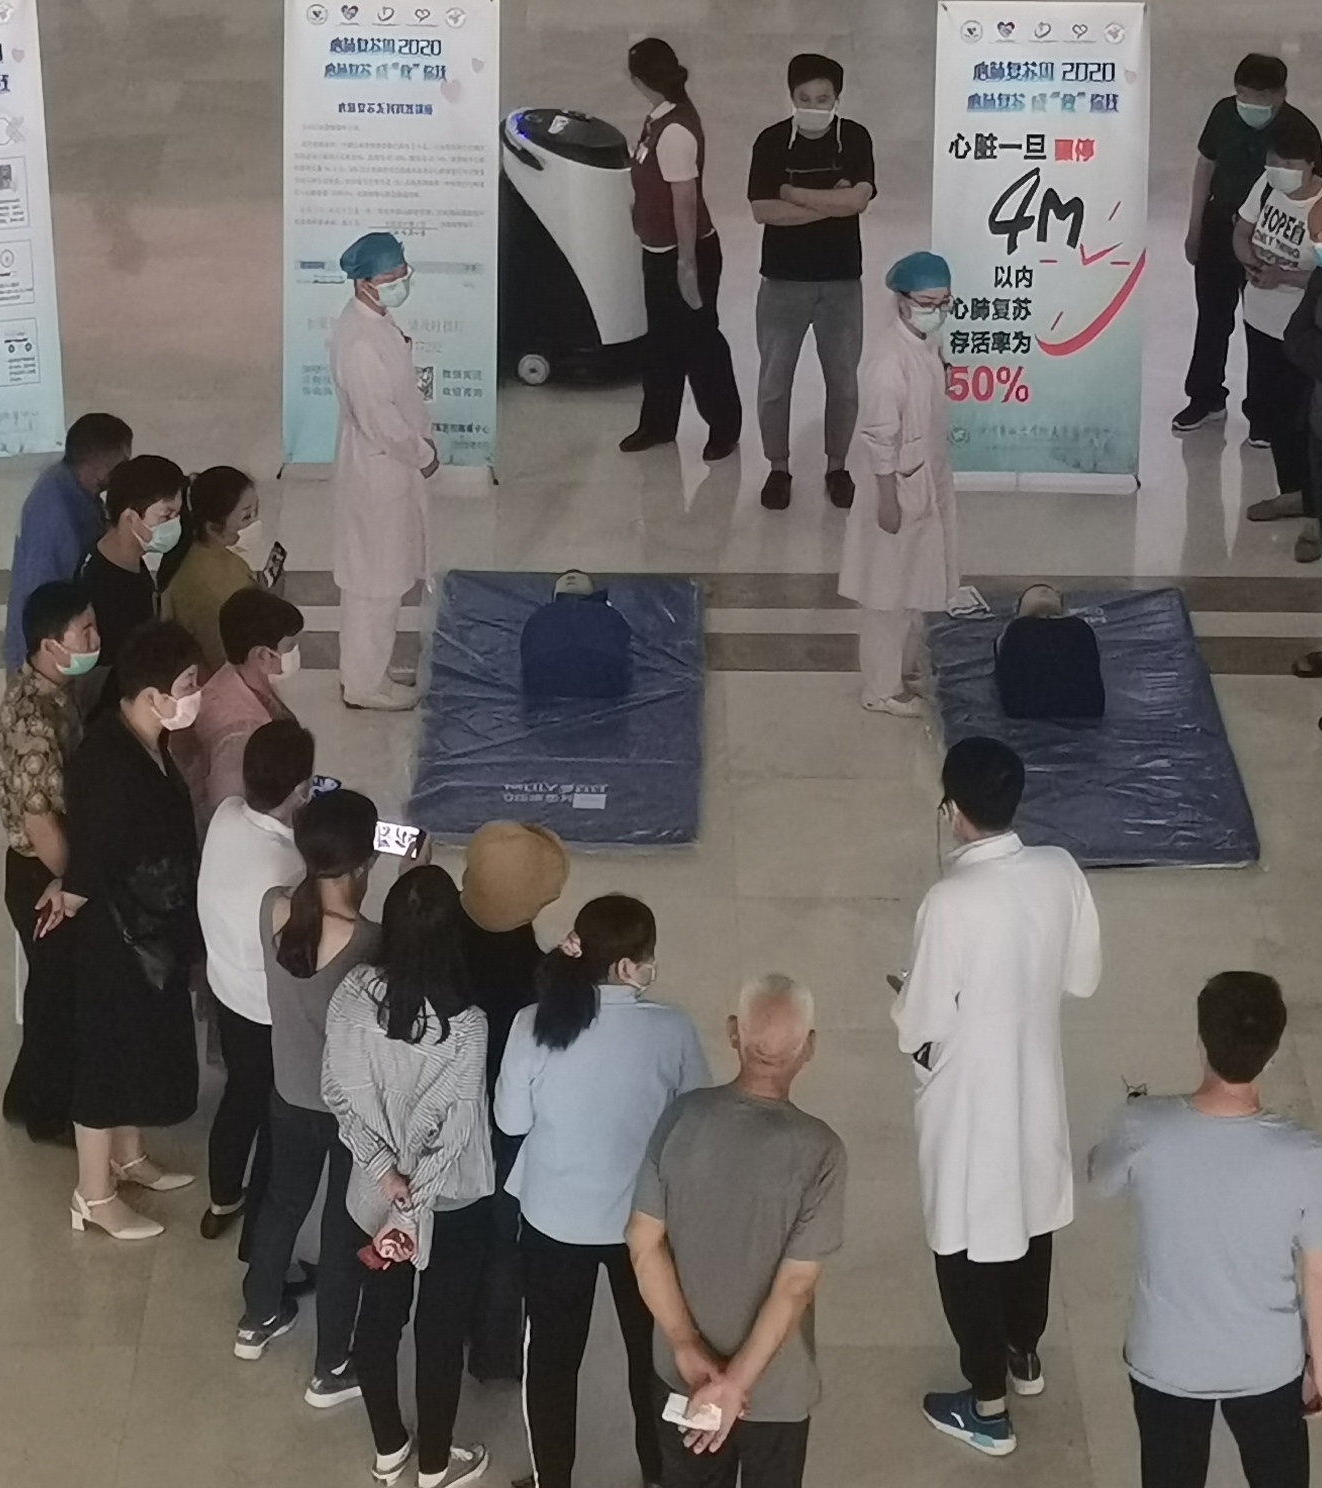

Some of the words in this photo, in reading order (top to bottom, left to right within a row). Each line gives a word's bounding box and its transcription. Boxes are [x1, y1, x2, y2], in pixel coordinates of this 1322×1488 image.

[398, 39, 442, 57] 2020
[1061, 62, 1115, 83] 2020
[988, 167, 1084, 255] 4M
[994, 265, 1033, 289] 以内
[950, 330, 1031, 354] 存活率为
[948, 365, 1029, 404] 50%
